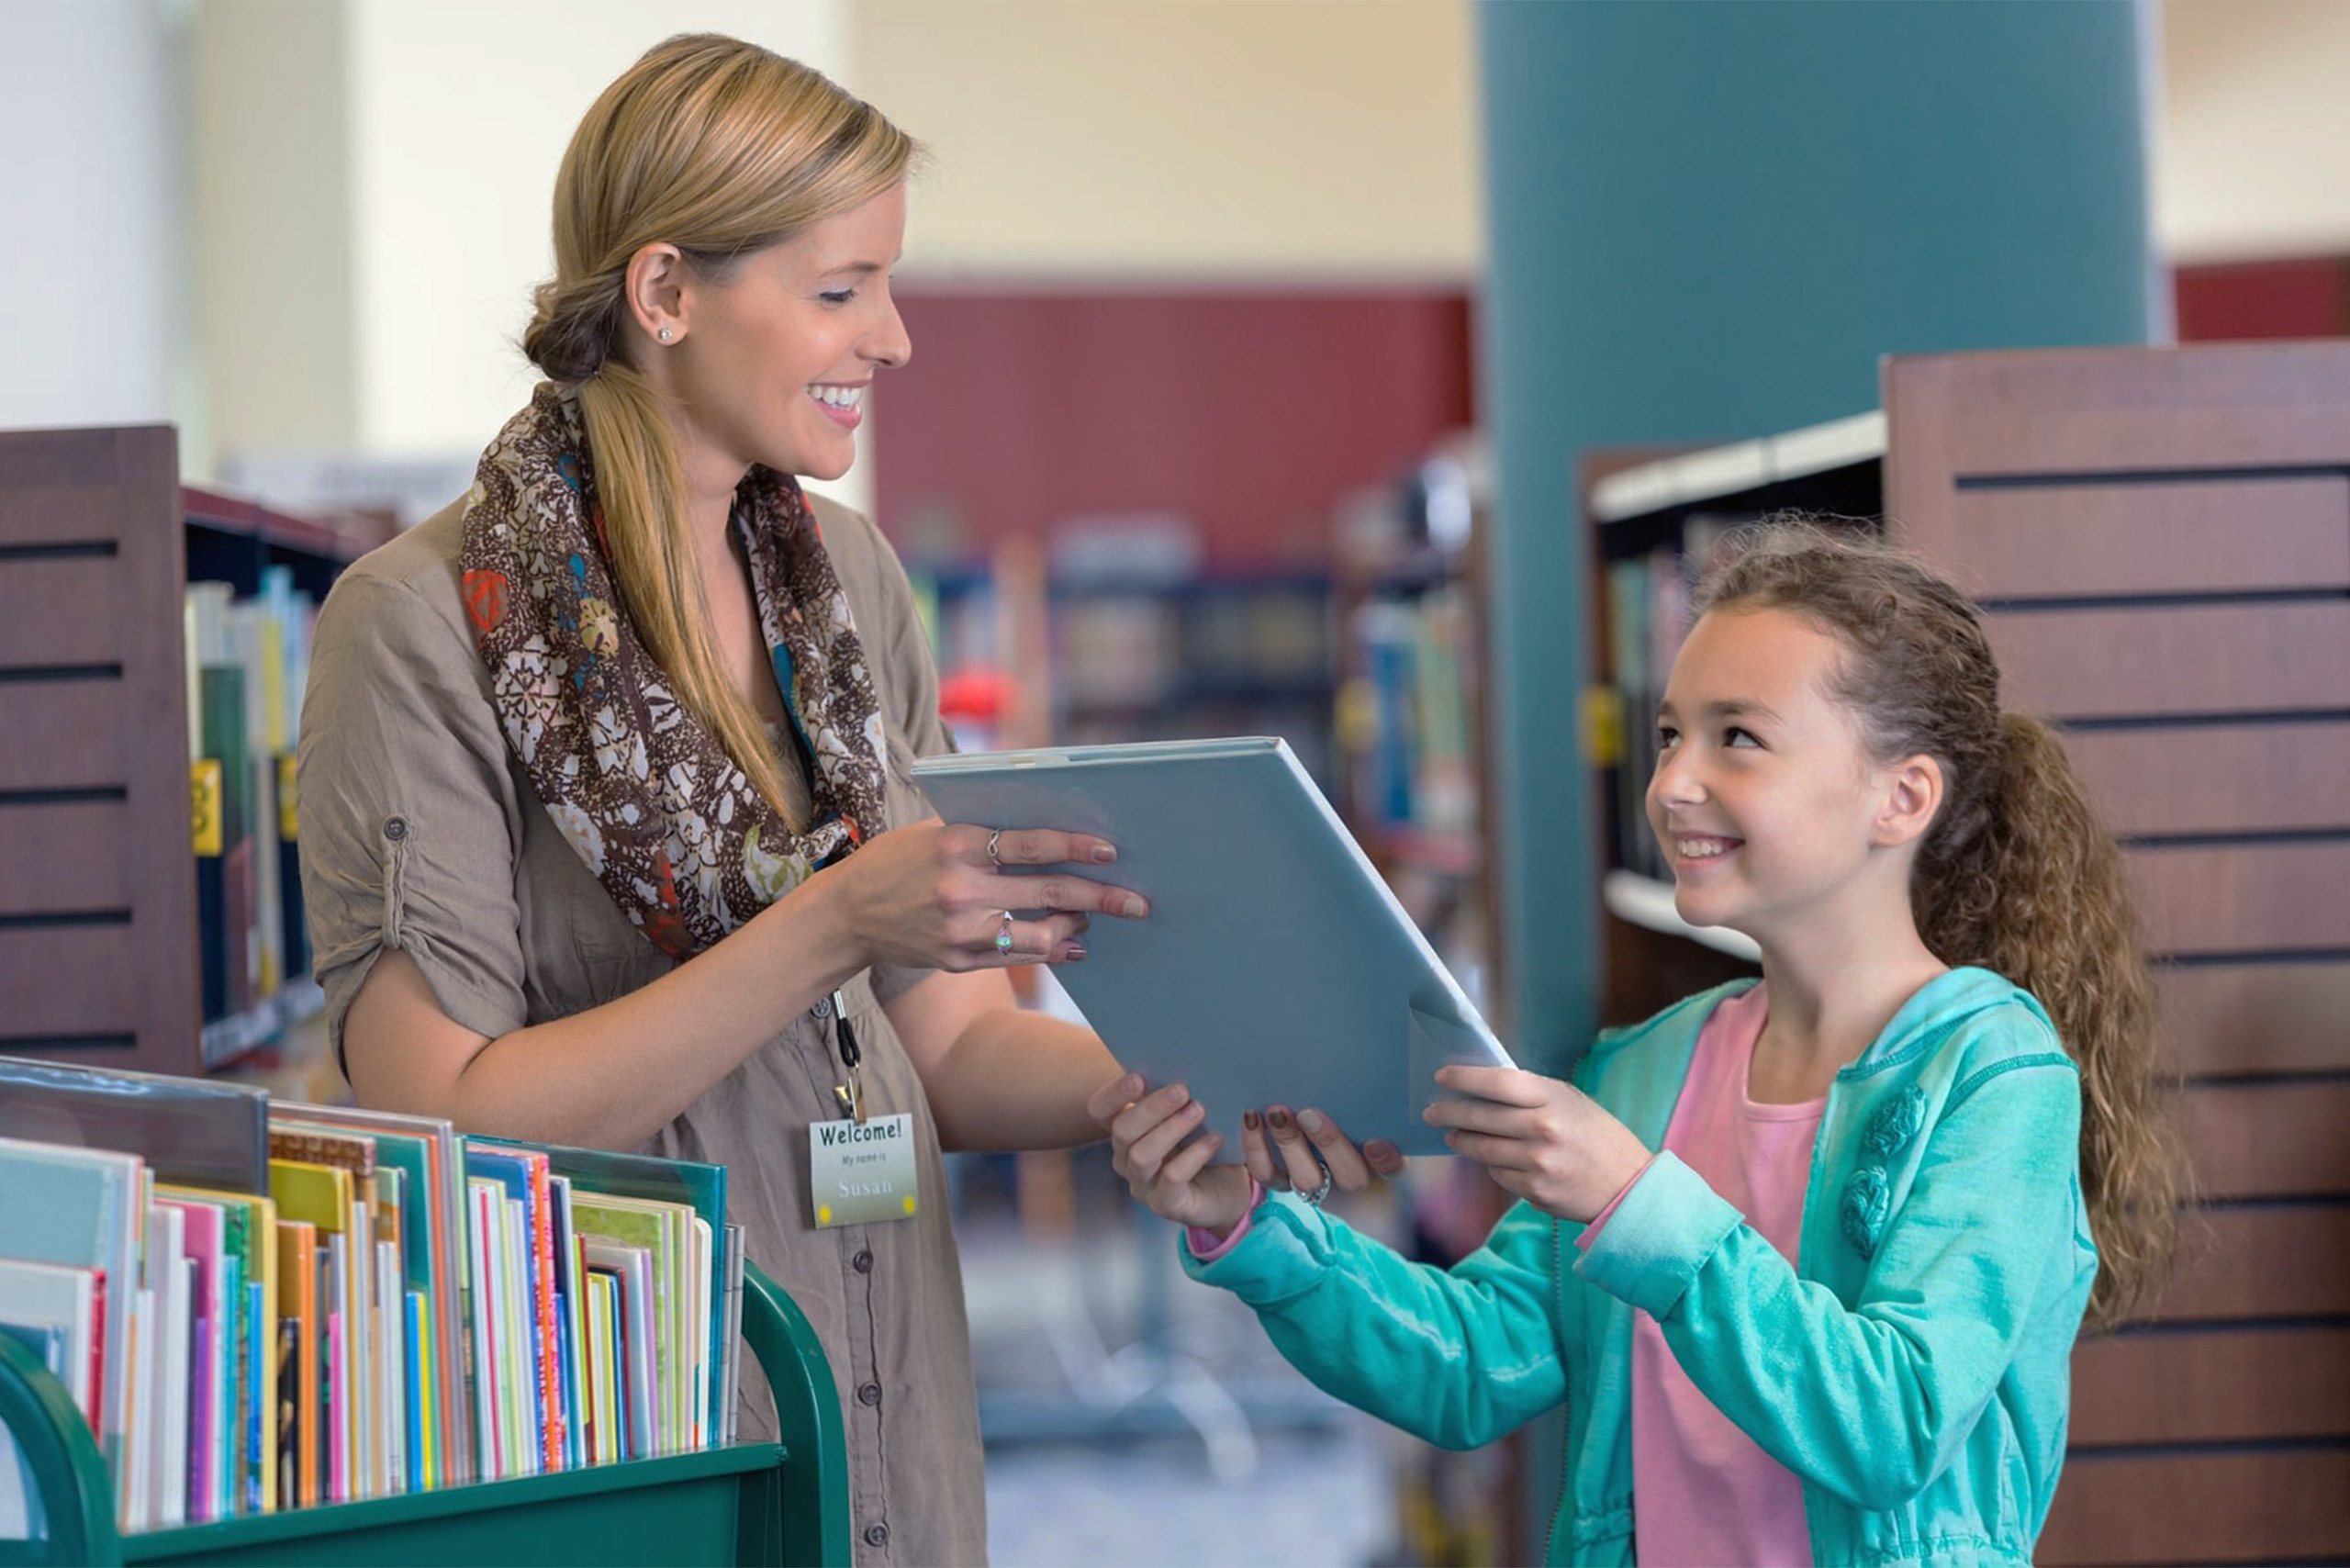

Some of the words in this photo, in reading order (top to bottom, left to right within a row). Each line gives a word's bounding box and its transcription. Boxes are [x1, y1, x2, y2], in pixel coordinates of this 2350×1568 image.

[820, 1117, 902, 1147] Welcome!
[842, 1154, 854, 1167] My
[856, 1153, 877, 1163] name
[879, 1152, 887, 1161] is
[838, 1179, 892, 1198] Susan
